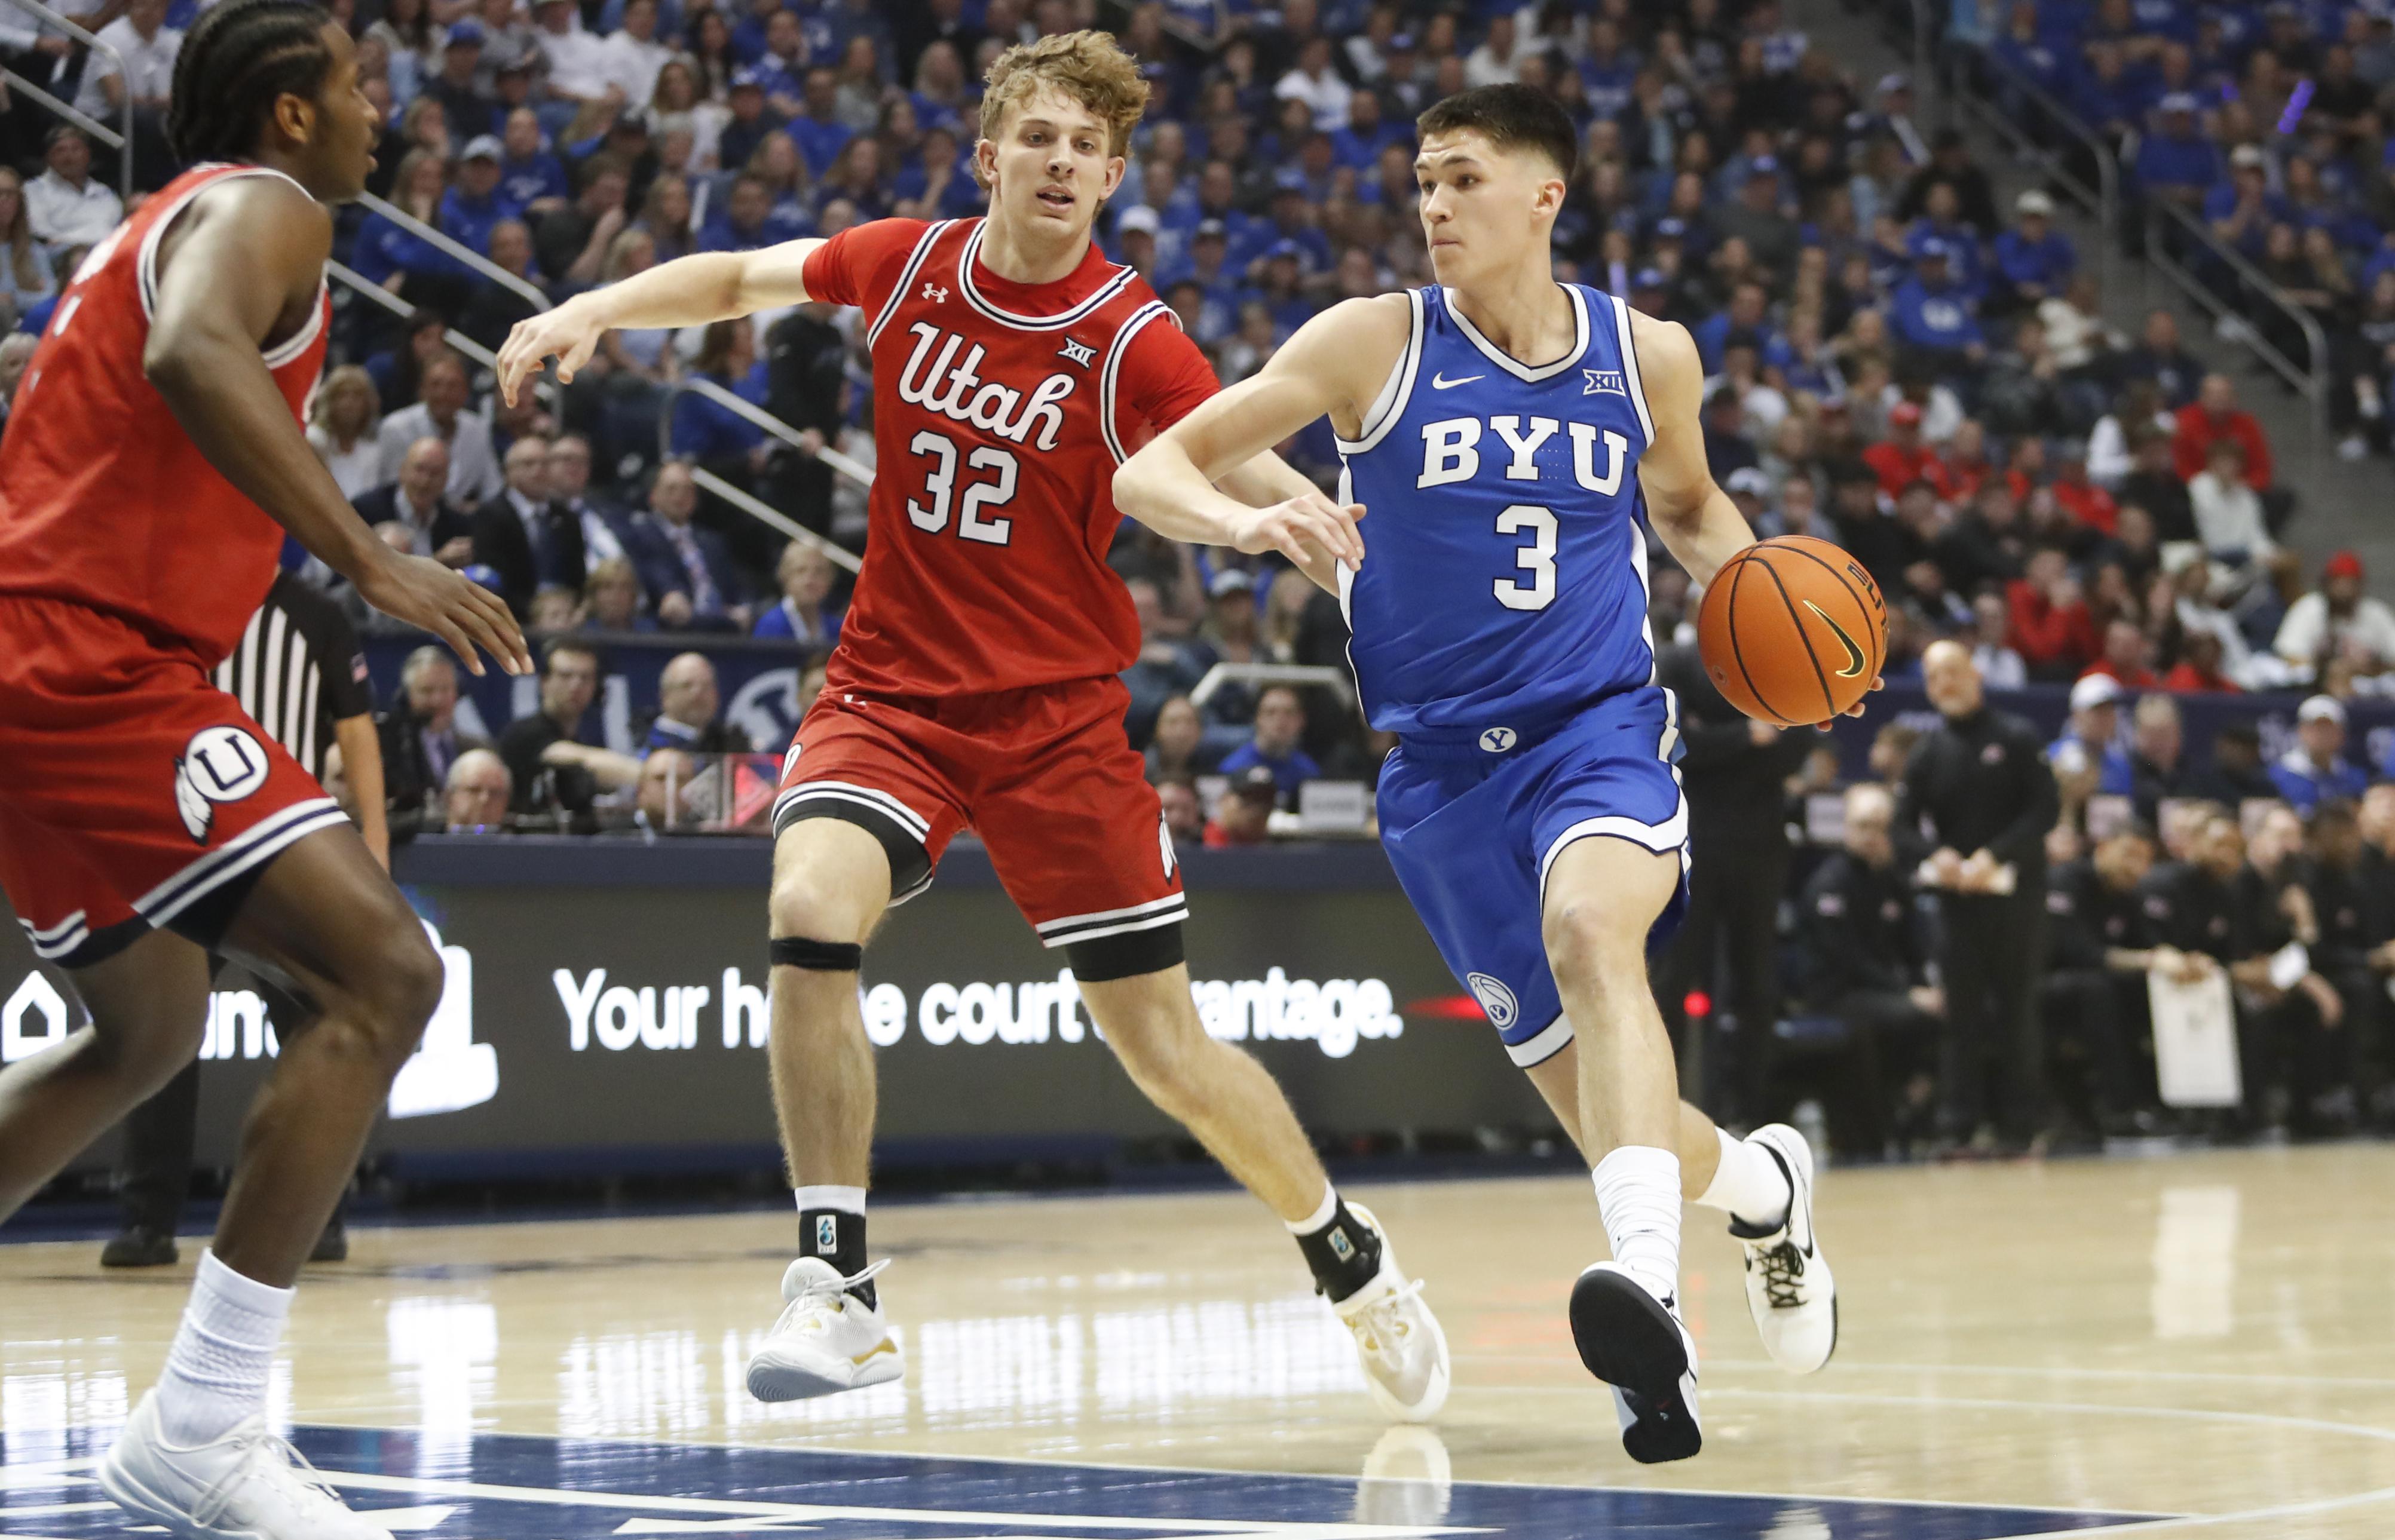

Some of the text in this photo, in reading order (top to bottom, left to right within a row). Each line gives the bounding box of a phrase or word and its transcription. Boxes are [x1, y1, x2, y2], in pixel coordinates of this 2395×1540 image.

[898, 321, 1076, 452] Utah
[906, 430, 1018, 546] 32
[1416, 414, 1629, 498] BYU
[1492, 504, 1559, 612] 3
[194, 734, 256, 792] U
[1484, 729, 1509, 750] Y
[552, 966, 1404, 1059] Your he court antage.
